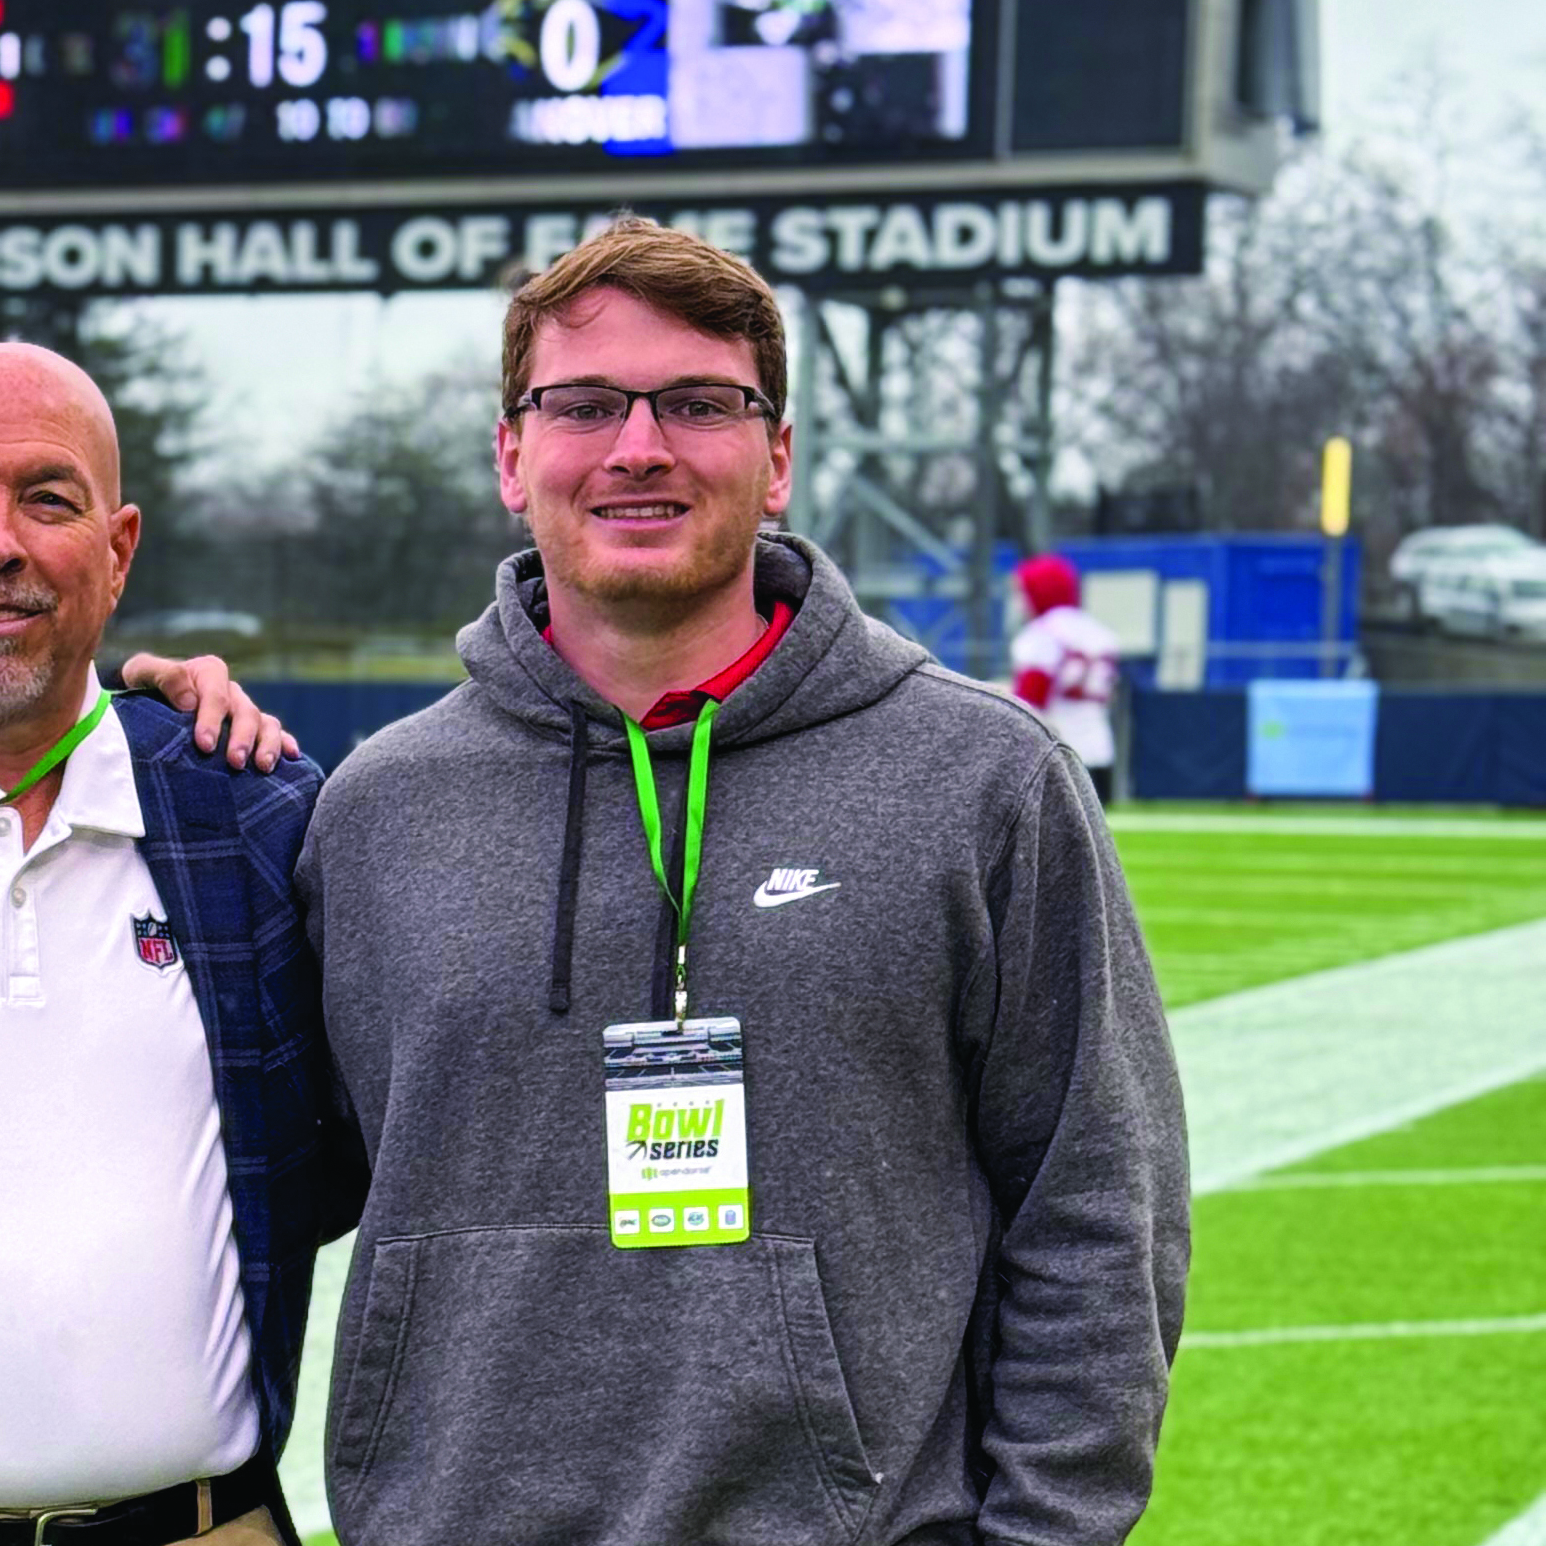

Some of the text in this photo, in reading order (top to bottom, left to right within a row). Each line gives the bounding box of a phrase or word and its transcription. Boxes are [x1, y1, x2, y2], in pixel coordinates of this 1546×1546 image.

[206, 2, 328, 88] :15
[540, 0, 600, 91] 0
[176, 218, 379, 283] HALL
[391, 213, 510, 283] OF
[771, 198, 1171, 274] STADIUM
[767, 868, 819, 890] NIKE
[140, 938, 174, 965] NFL
[627, 1099, 725, 1142] Bowl
[651, 1140, 718, 1160] series
